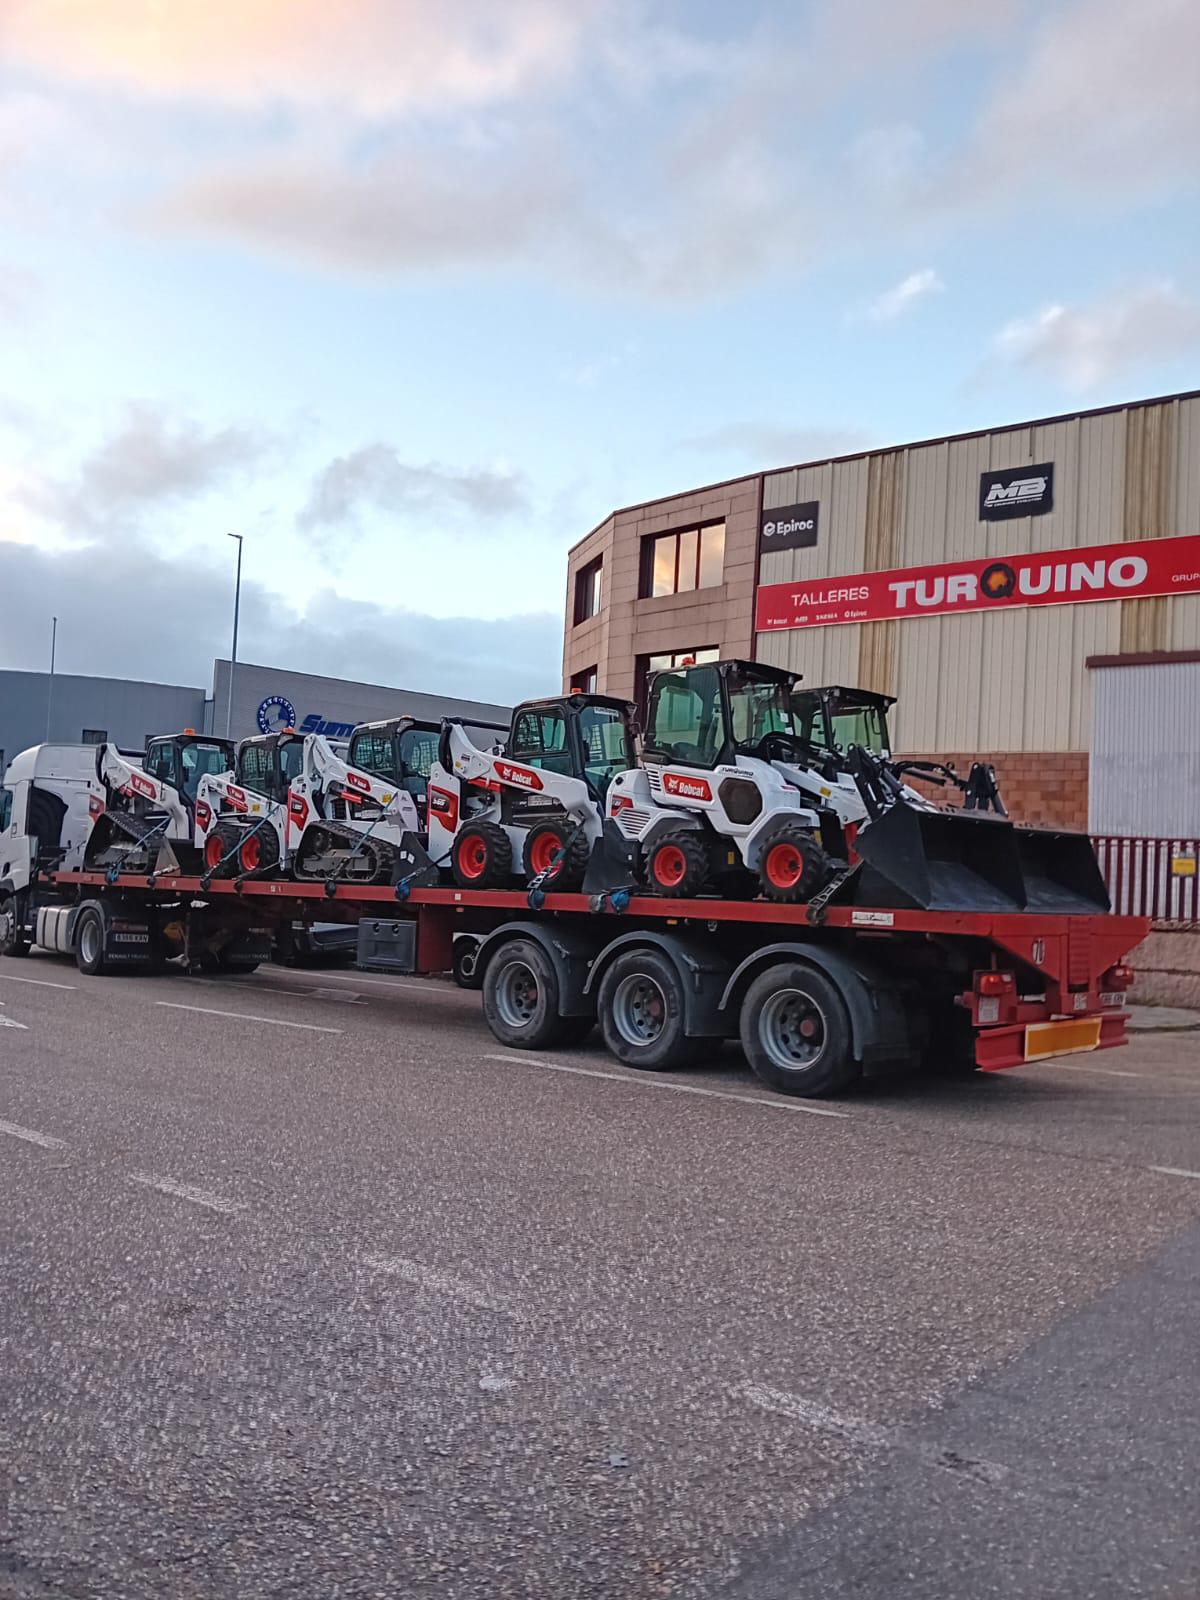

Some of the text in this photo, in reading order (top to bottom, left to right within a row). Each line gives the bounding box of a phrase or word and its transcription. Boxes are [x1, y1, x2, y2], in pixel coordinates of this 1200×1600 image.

[987, 477, 1046, 500] MB
[777, 518, 813, 536] Epiroc
[791, 556, 1200, 608] TALLERES TURQUINO GRUP
[299, 714, 356, 738] Sum
[511, 771, 532, 786] Bobcat
[678, 782, 705, 798] Bobcat
